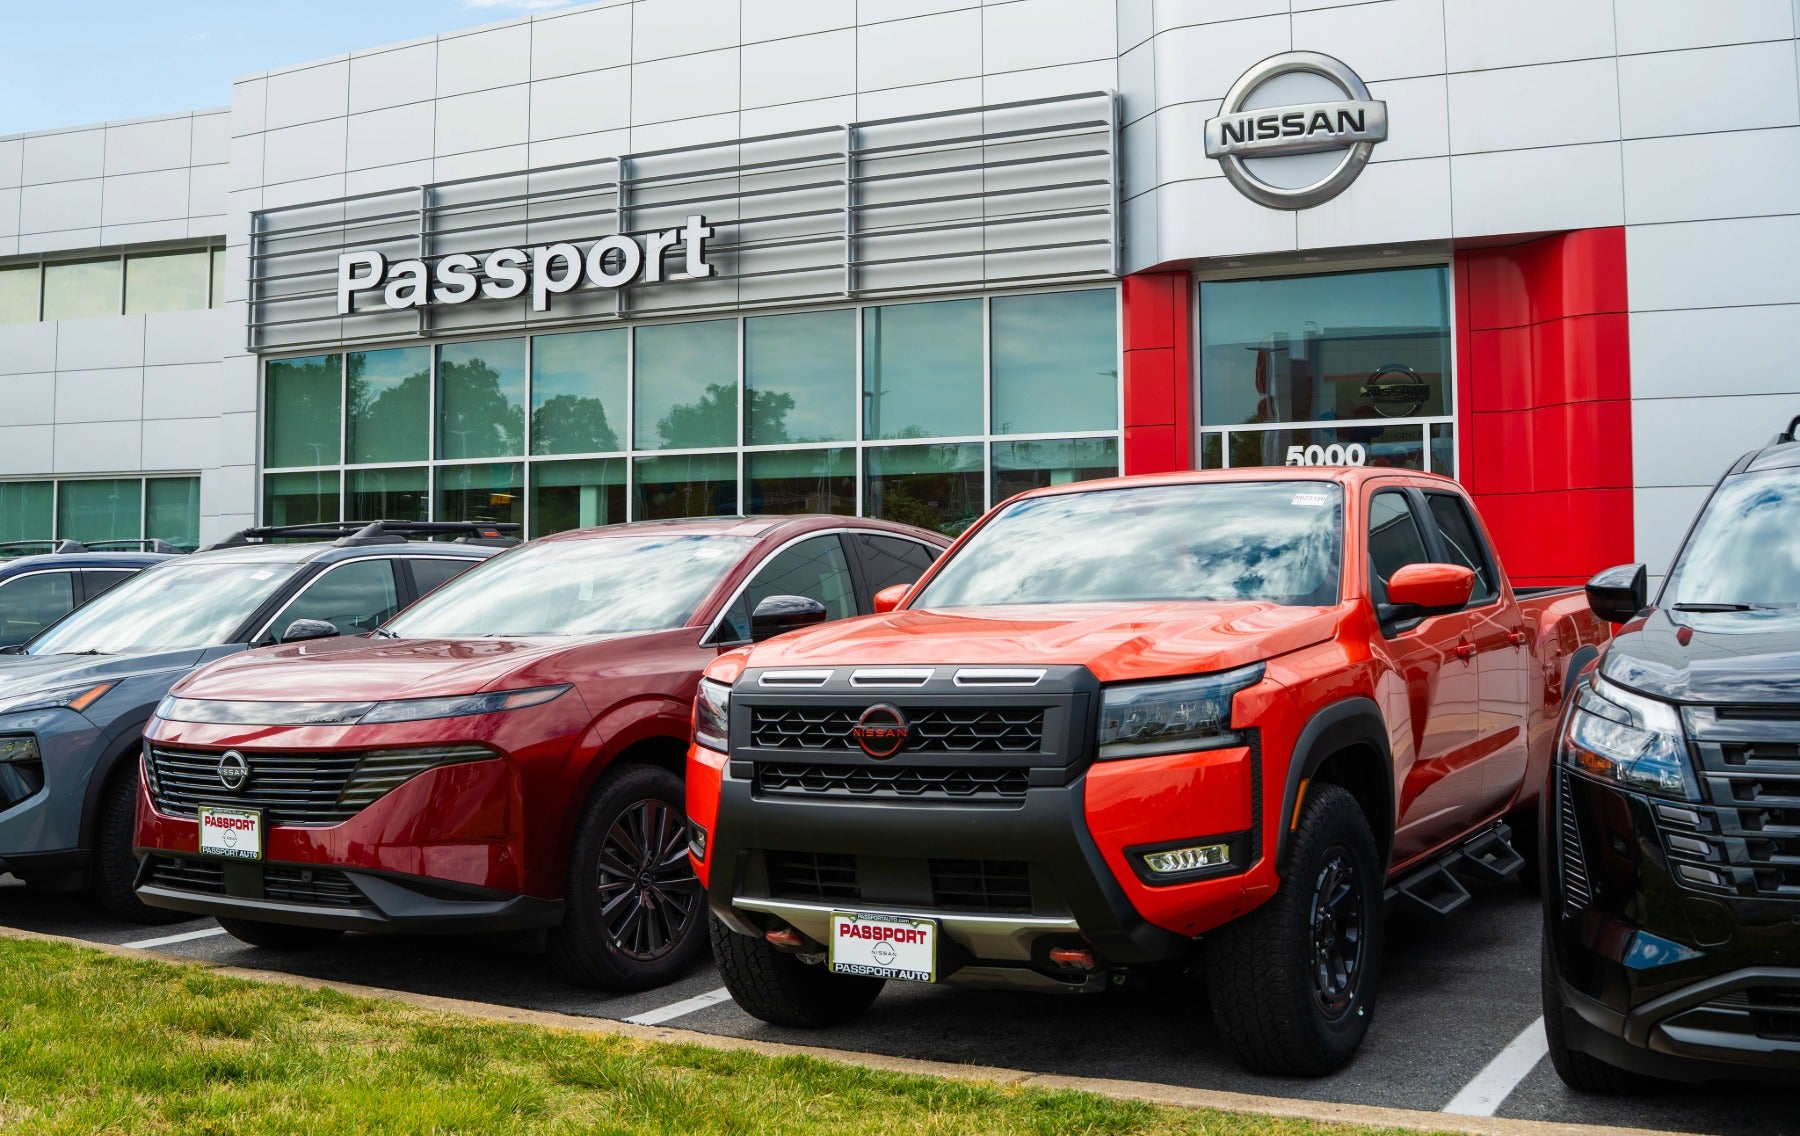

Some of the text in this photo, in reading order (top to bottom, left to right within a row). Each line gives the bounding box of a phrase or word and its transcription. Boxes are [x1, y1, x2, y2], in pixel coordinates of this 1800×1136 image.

[1221, 108, 1366, 146] NISSAN
[337, 214, 716, 314] Passport
[1285, 443, 1366, 466] 5000
[853, 728, 908, 737] NISSAN
[204, 816, 255, 831] PASSPORT
[202, 847, 258, 859] PASSPORT AUTO
[840, 924, 927, 944] PASSPORT
[871, 949, 897, 957] NISSAN
[835, 964, 929, 981] PASSPORT AUTO
